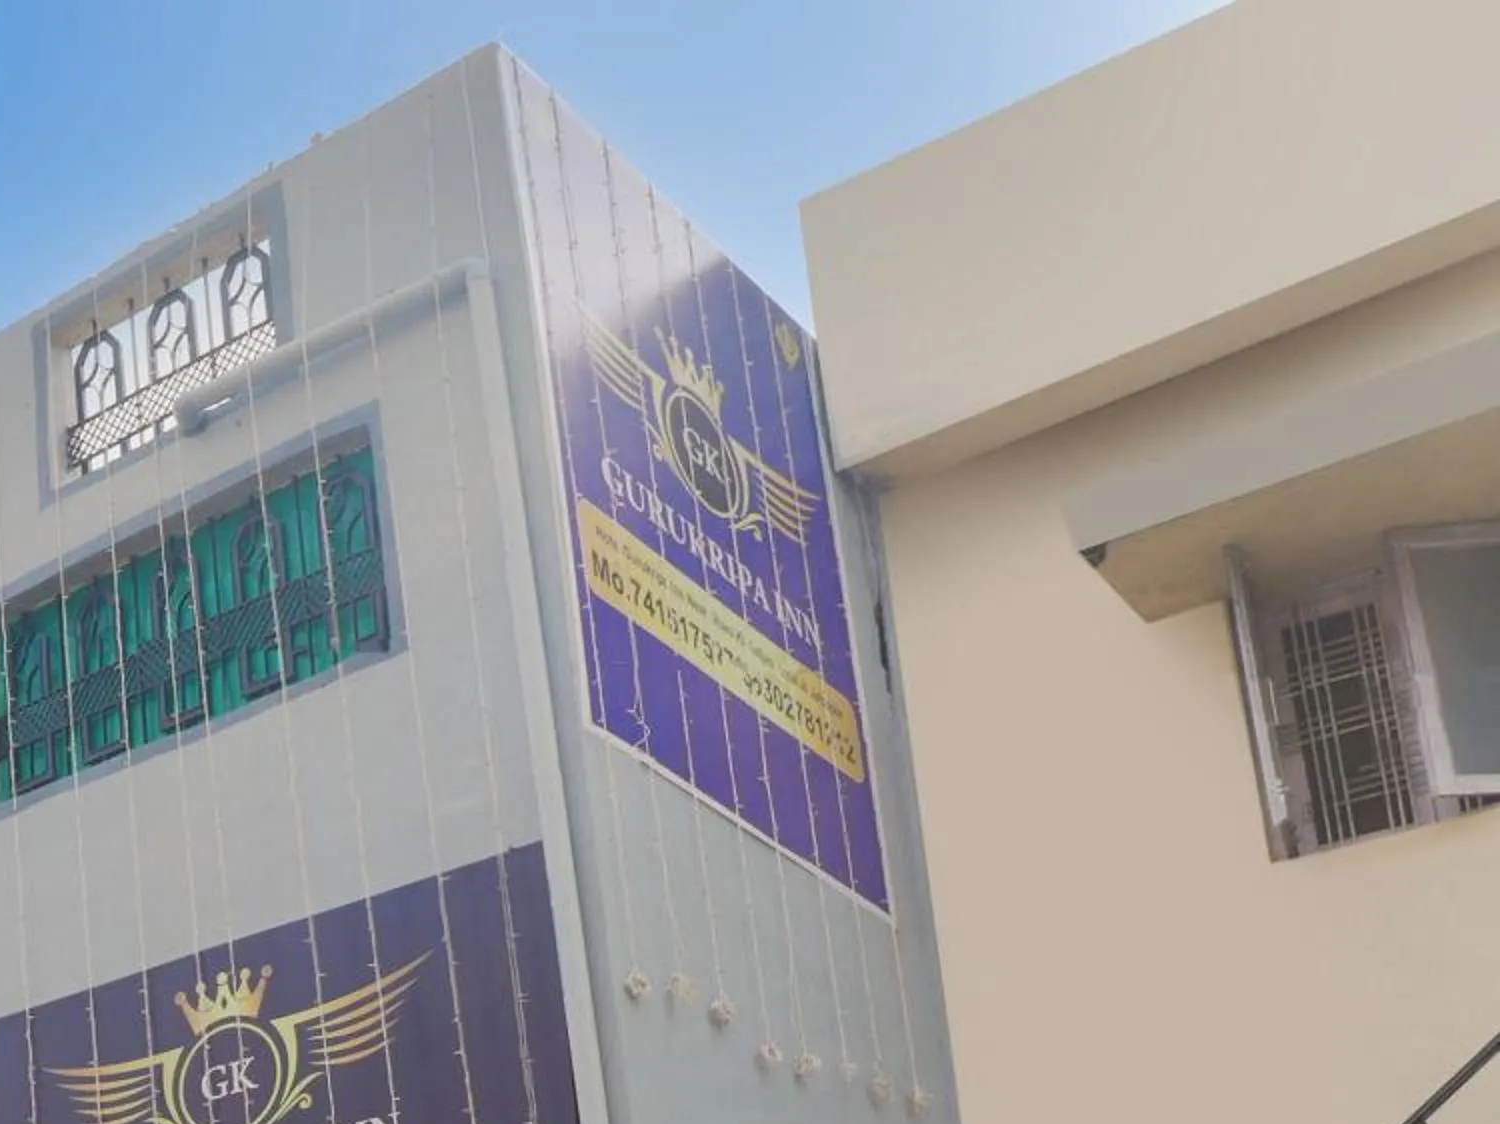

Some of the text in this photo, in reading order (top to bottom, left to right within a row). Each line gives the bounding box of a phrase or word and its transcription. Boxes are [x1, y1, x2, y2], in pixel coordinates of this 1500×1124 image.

[682, 427, 727, 484] GK
[601, 457, 772, 615] GURUKRIPA
[773, 590, 823, 647] INN
[201, 1055, 259, 1101] GK
